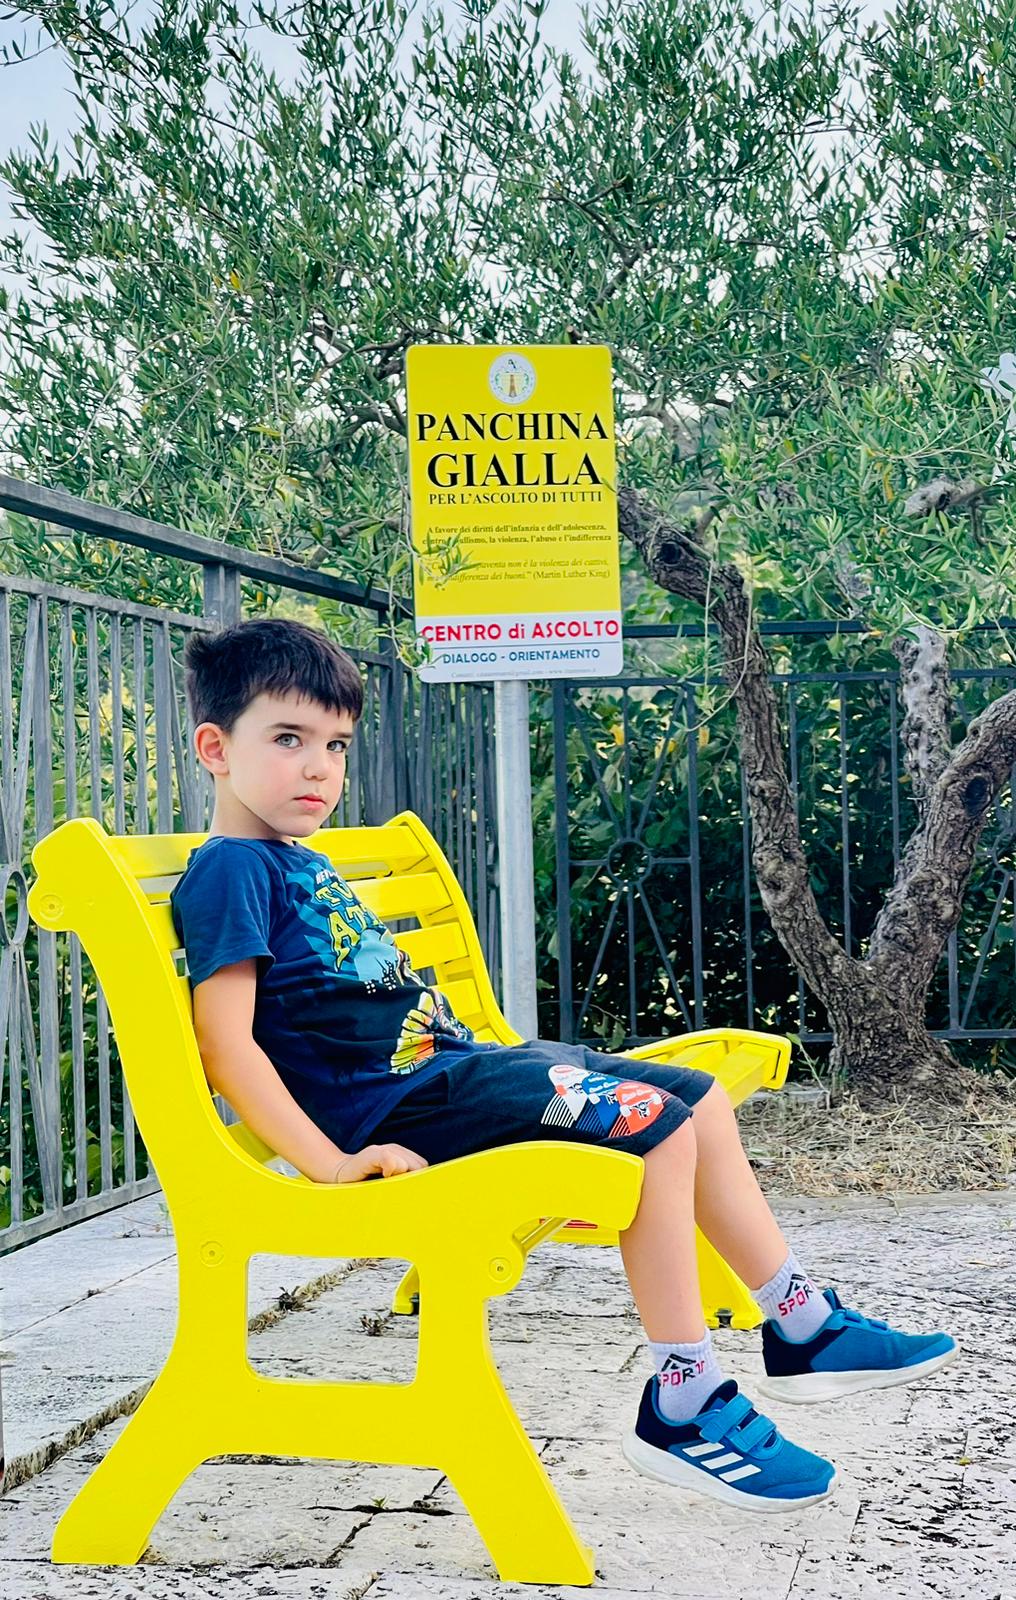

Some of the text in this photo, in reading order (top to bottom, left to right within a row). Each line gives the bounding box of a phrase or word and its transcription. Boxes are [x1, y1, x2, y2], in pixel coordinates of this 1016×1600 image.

[415, 412, 609, 441] PANCHINA
[427, 452, 603, 488] GIALLA
[429, 491, 602, 505] PER L'ASCOLTO DI TUTTI
[435, 526, 458, 534] favore
[460, 525, 471, 533] dei
[472, 525, 494, 533] diritti
[495, 524, 540, 533] dell'infanzia
[547, 523, 607, 532] dell'adolescenza,
[456, 535, 488, 544] ullismo,
[489, 536, 496, 544] la
[498, 535, 529, 544] violenza,
[531, 535, 557, 543] l'abuso
[564, 534, 612, 542] l'indifferenza
[530, 559, 537, 567] la
[539, 559, 570, 567] violenza
[571, 558, 583, 566] dei
[490, 572, 503, 580] dei
[533, 570, 561, 580] (Martin
[563, 570, 587, 578] Luther
[589, 569, 611, 579] King)
[421, 619, 620, 643] CENTRO di ASCOLTO
[442, 651, 497, 664] DIALOGO
[508, 648, 601, 662] ORIENTAMENTO
